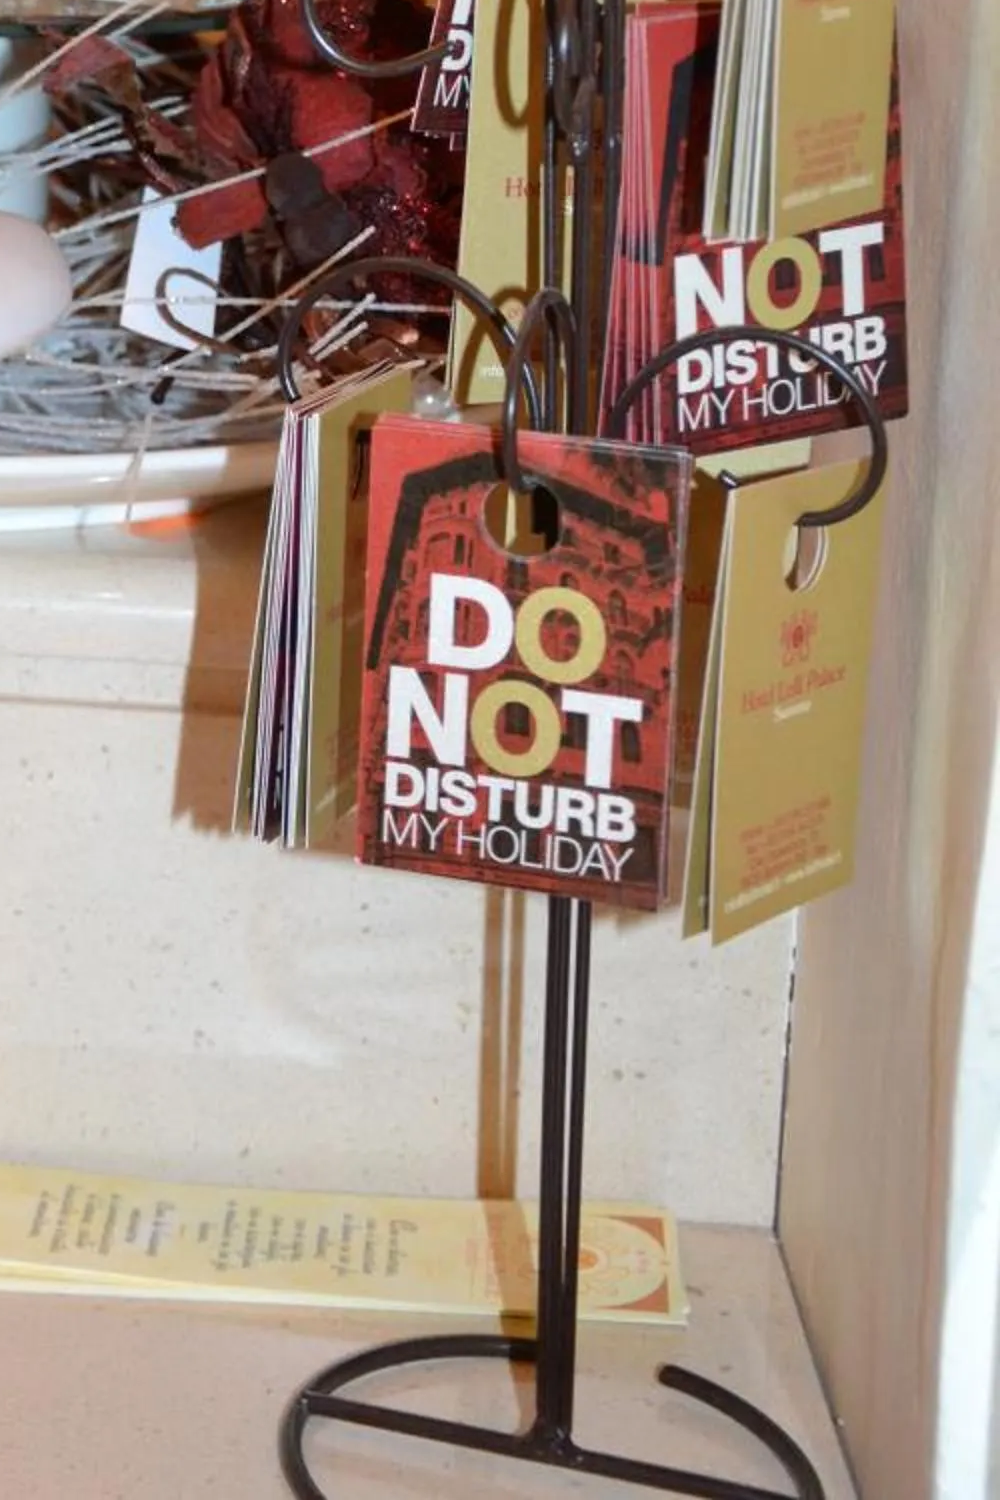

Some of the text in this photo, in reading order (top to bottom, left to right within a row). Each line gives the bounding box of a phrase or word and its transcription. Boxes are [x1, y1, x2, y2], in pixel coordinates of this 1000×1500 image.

[674, 222, 884, 340] NOT
[676, 316, 887, 394] DISTURB
[678, 390, 735, 432] MY
[427, 573, 606, 684] DO
[387, 665, 643, 789] NOT
[385, 761, 636, 843] DISTURB
[382, 808, 448, 851] MY
[457, 819, 634, 882] HOLIDAY
